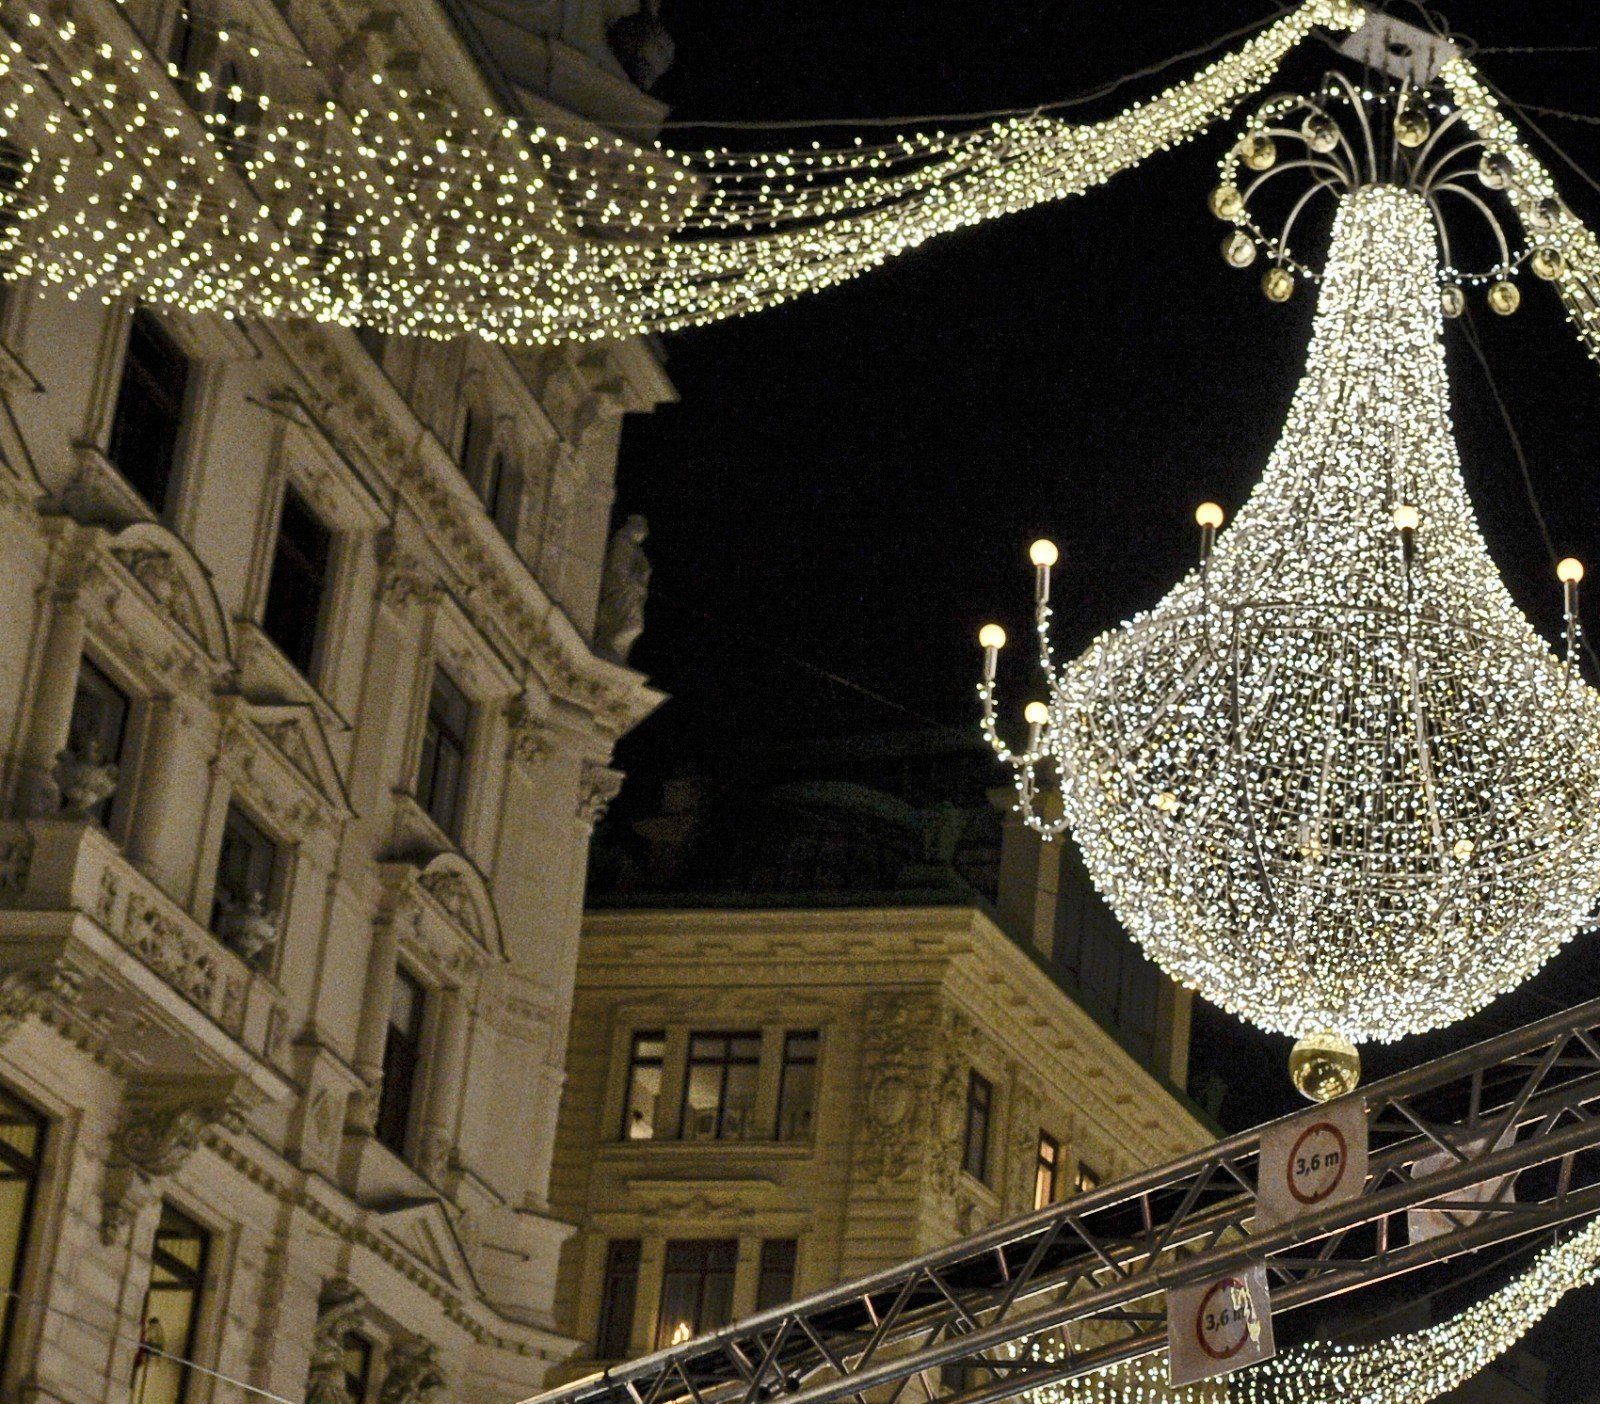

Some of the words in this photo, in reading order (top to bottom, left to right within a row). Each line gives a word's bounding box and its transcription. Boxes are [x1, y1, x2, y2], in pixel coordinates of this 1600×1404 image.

[1296, 1153, 1320, 1176] 3,6
[1324, 1151, 1340, 1167] m
[1205, 1308, 1229, 1331] 3,6
